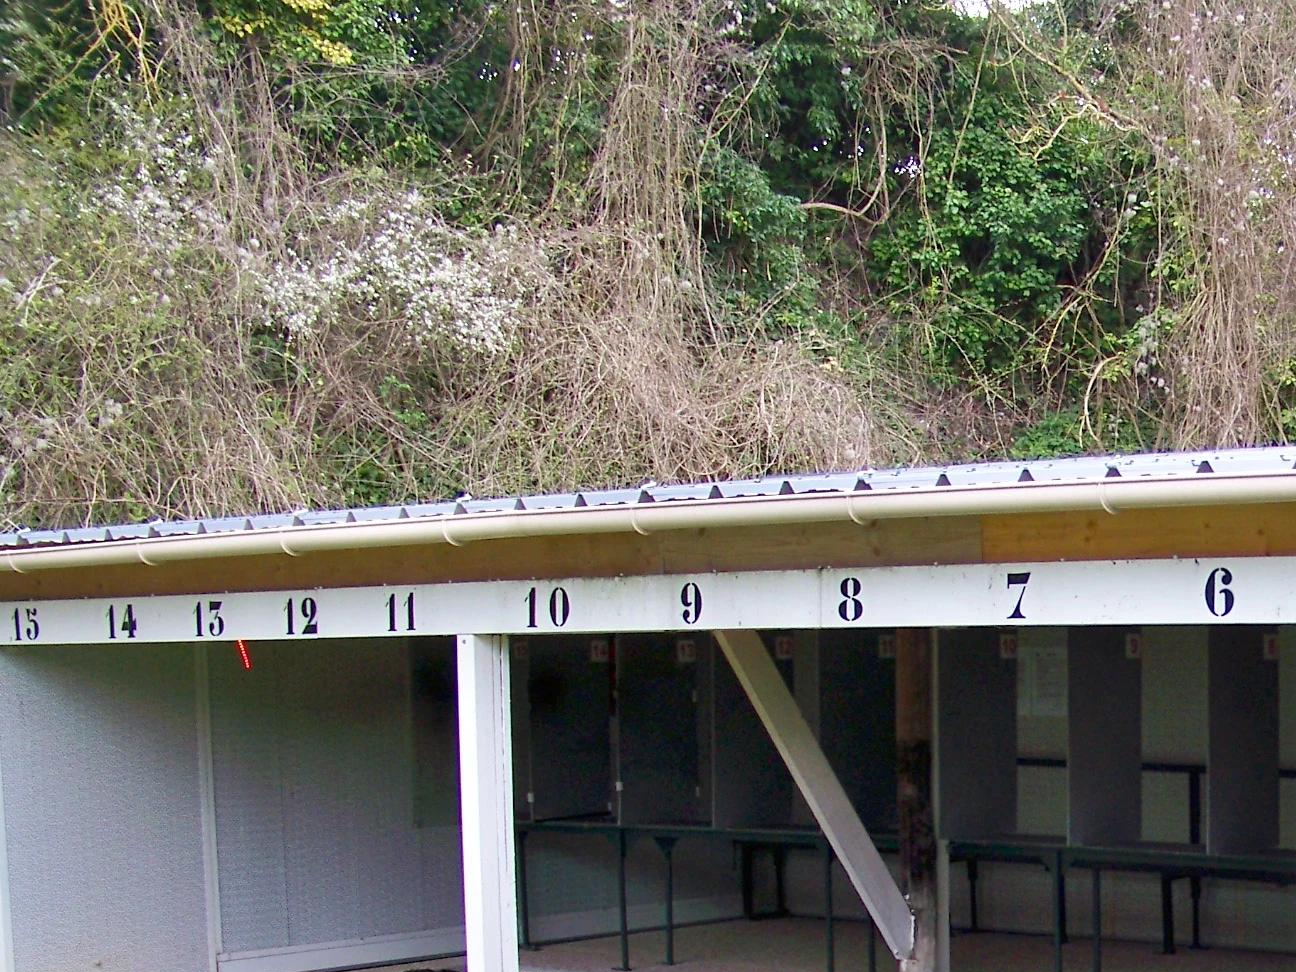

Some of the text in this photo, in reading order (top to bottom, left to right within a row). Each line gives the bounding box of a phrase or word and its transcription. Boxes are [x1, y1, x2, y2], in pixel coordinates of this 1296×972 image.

[526, 585, 570, 629] 10
[680, 582, 703, 625] 9
[838, 577, 863, 622] 8
[1006, 571, 1031, 619] 7
[1204, 567, 1235, 617] 6
[13, 606, 40, 640] 15
[108, 603, 138, 638] 14
[194, 600, 223, 637] 13
[286, 597, 318, 635] 12
[386, 592, 416, 632] 11
[680, 643, 693, 658] 13
[778, 639, 792, 655] 12
[1002, 638, 1017, 655] 10
[1129, 637, 1138, 654] 9
